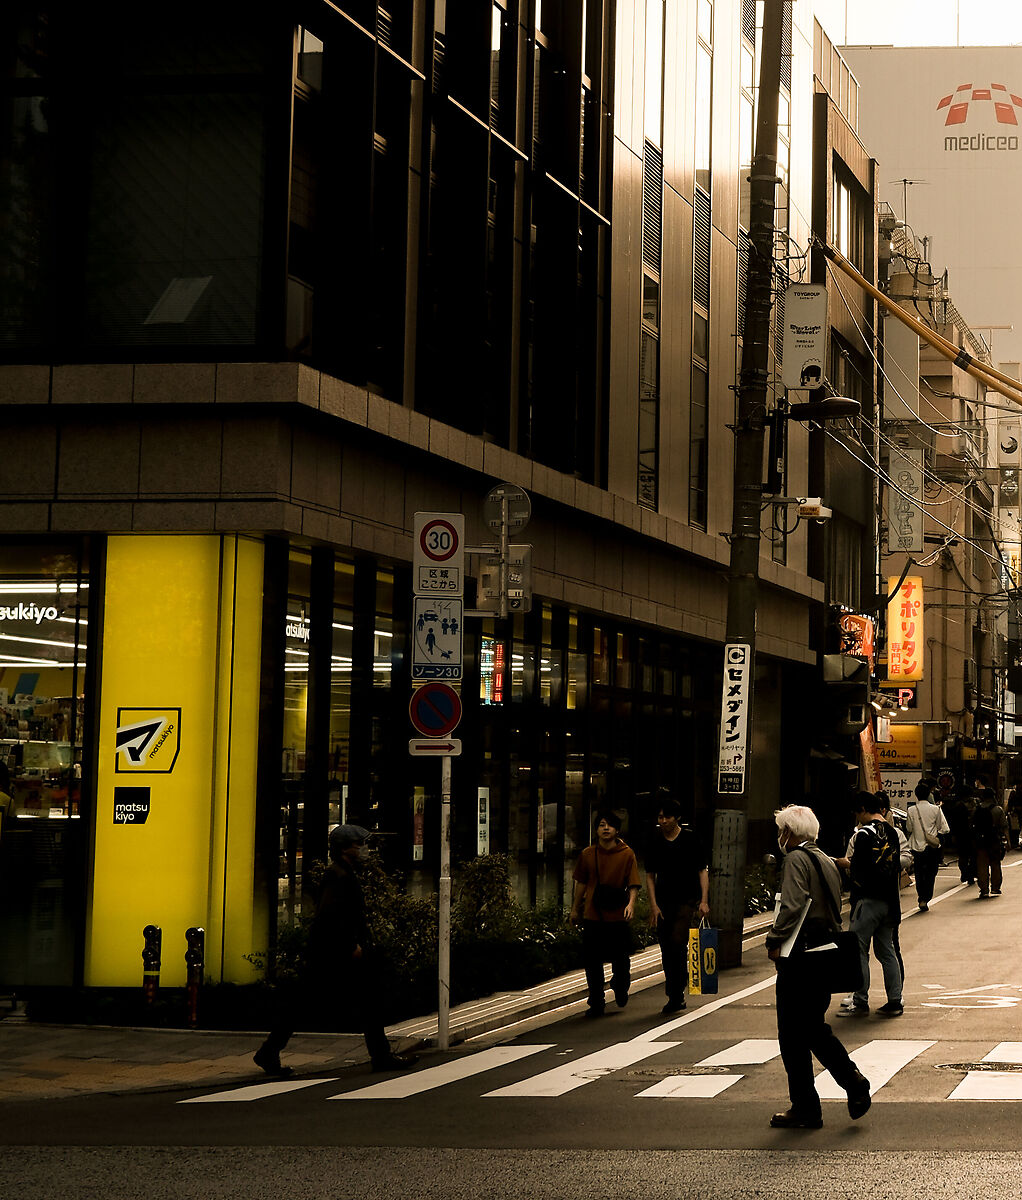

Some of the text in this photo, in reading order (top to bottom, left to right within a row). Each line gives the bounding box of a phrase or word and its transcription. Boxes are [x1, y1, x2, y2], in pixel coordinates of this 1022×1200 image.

[944, 133, 1018, 150] mediceo
[428, 531, 450, 550] 30
[429, 568, 449, 579] 区域
[421, 579, 457, 590] ここから
[900, 581, 921, 675] ナポリタン
[890, 642, 901, 675] 専門店
[726, 668, 743, 743] セメダイン
[149, 724, 175, 760] matsukiyo
[880, 749, 897, 758] 440
[115, 803, 148, 812] matsu
[115, 811, 135, 825] kiyo
